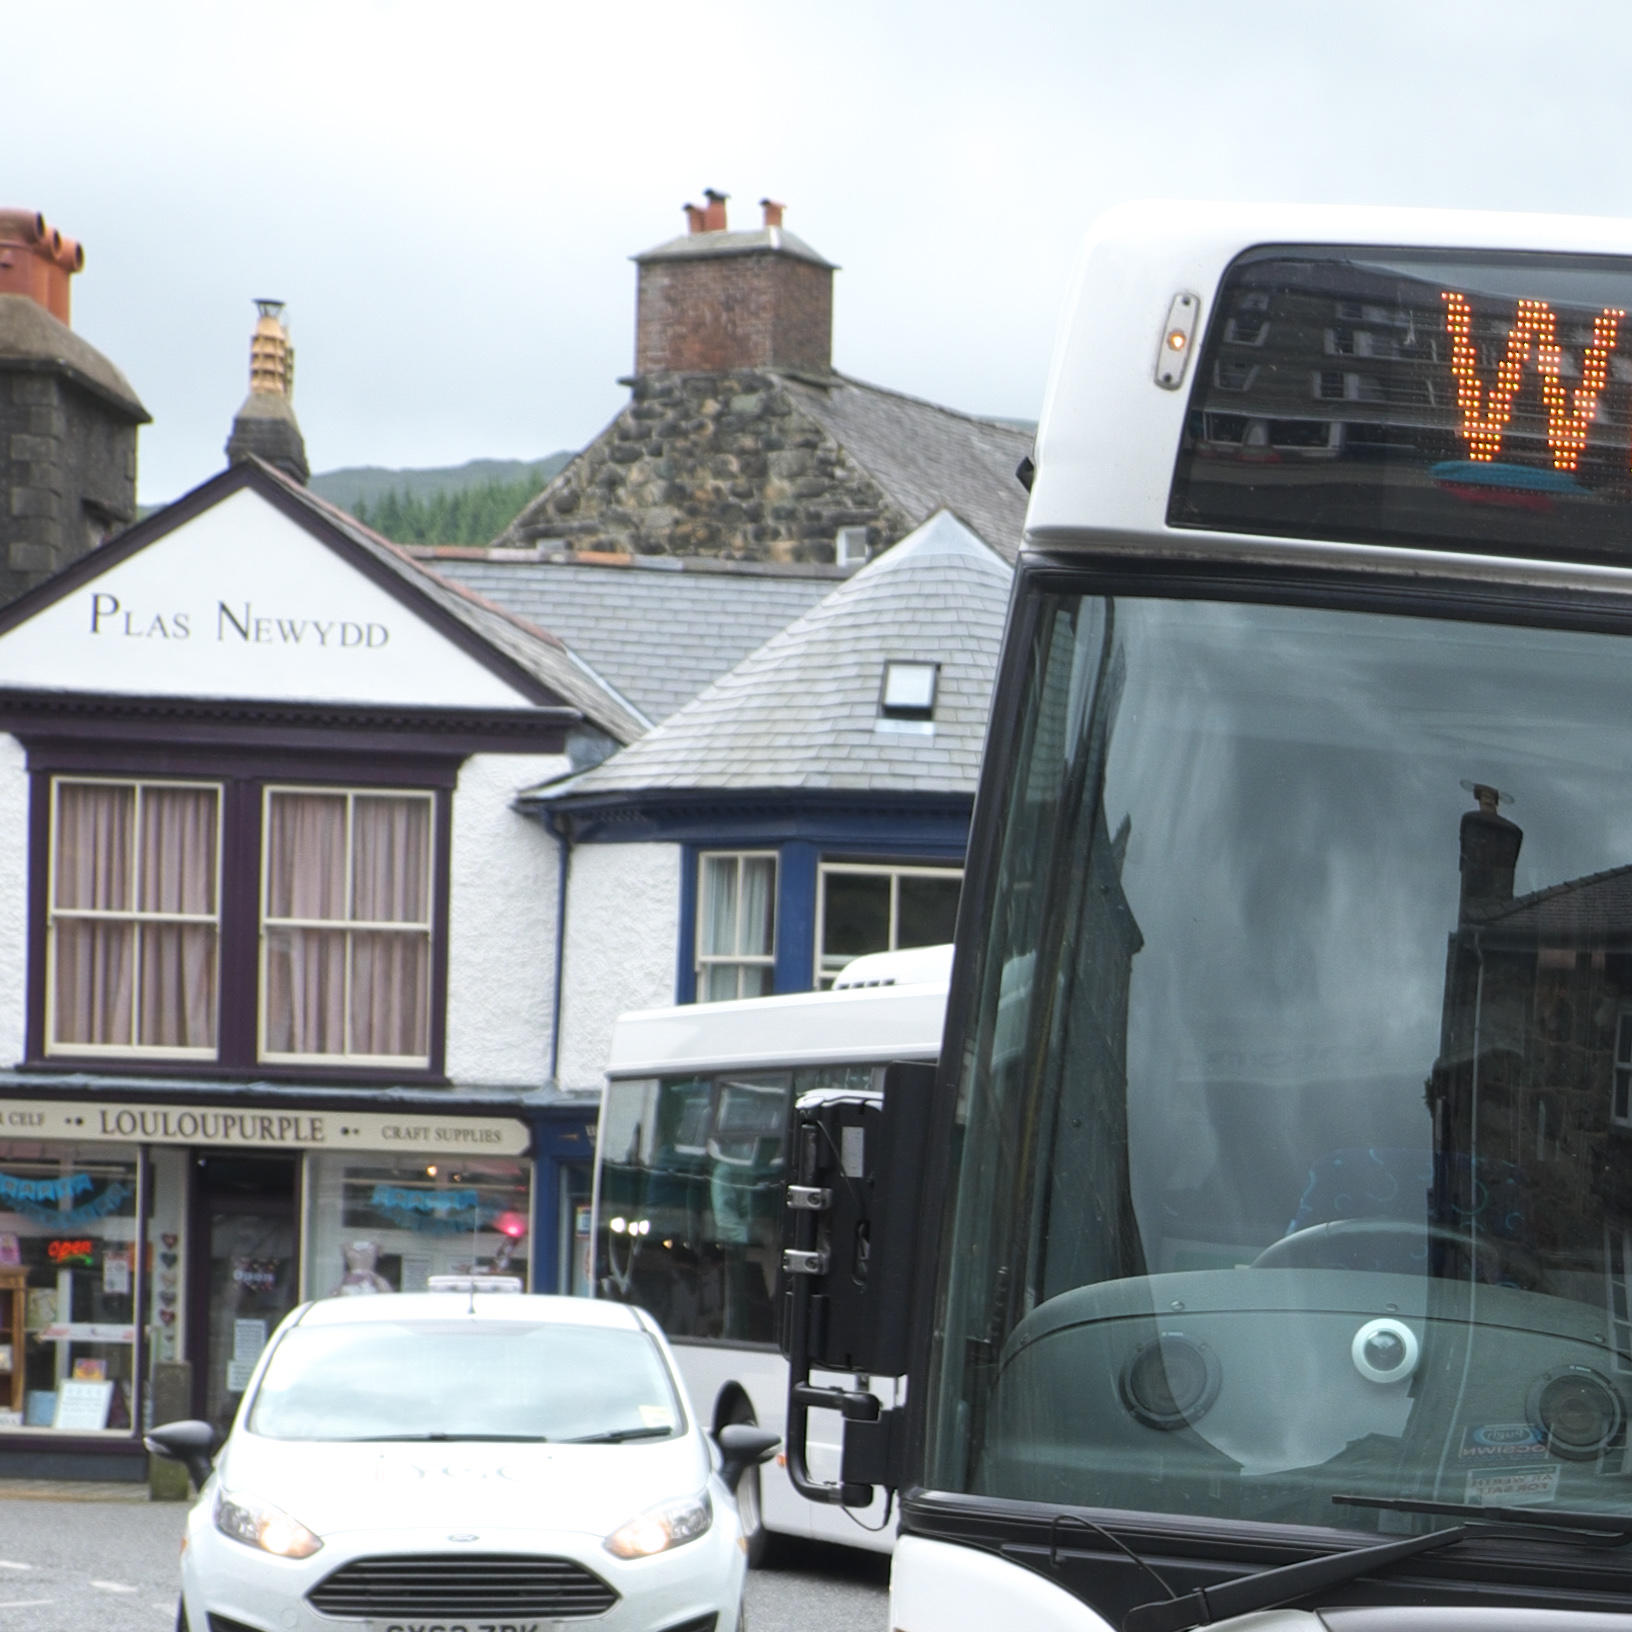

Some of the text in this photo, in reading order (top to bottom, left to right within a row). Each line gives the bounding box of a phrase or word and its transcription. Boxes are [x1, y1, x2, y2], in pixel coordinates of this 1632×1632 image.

[99, 1109, 326, 1143] LOULOUPURPLE
[381, 1125, 502, 1144] CRAFT SUPPLIES
